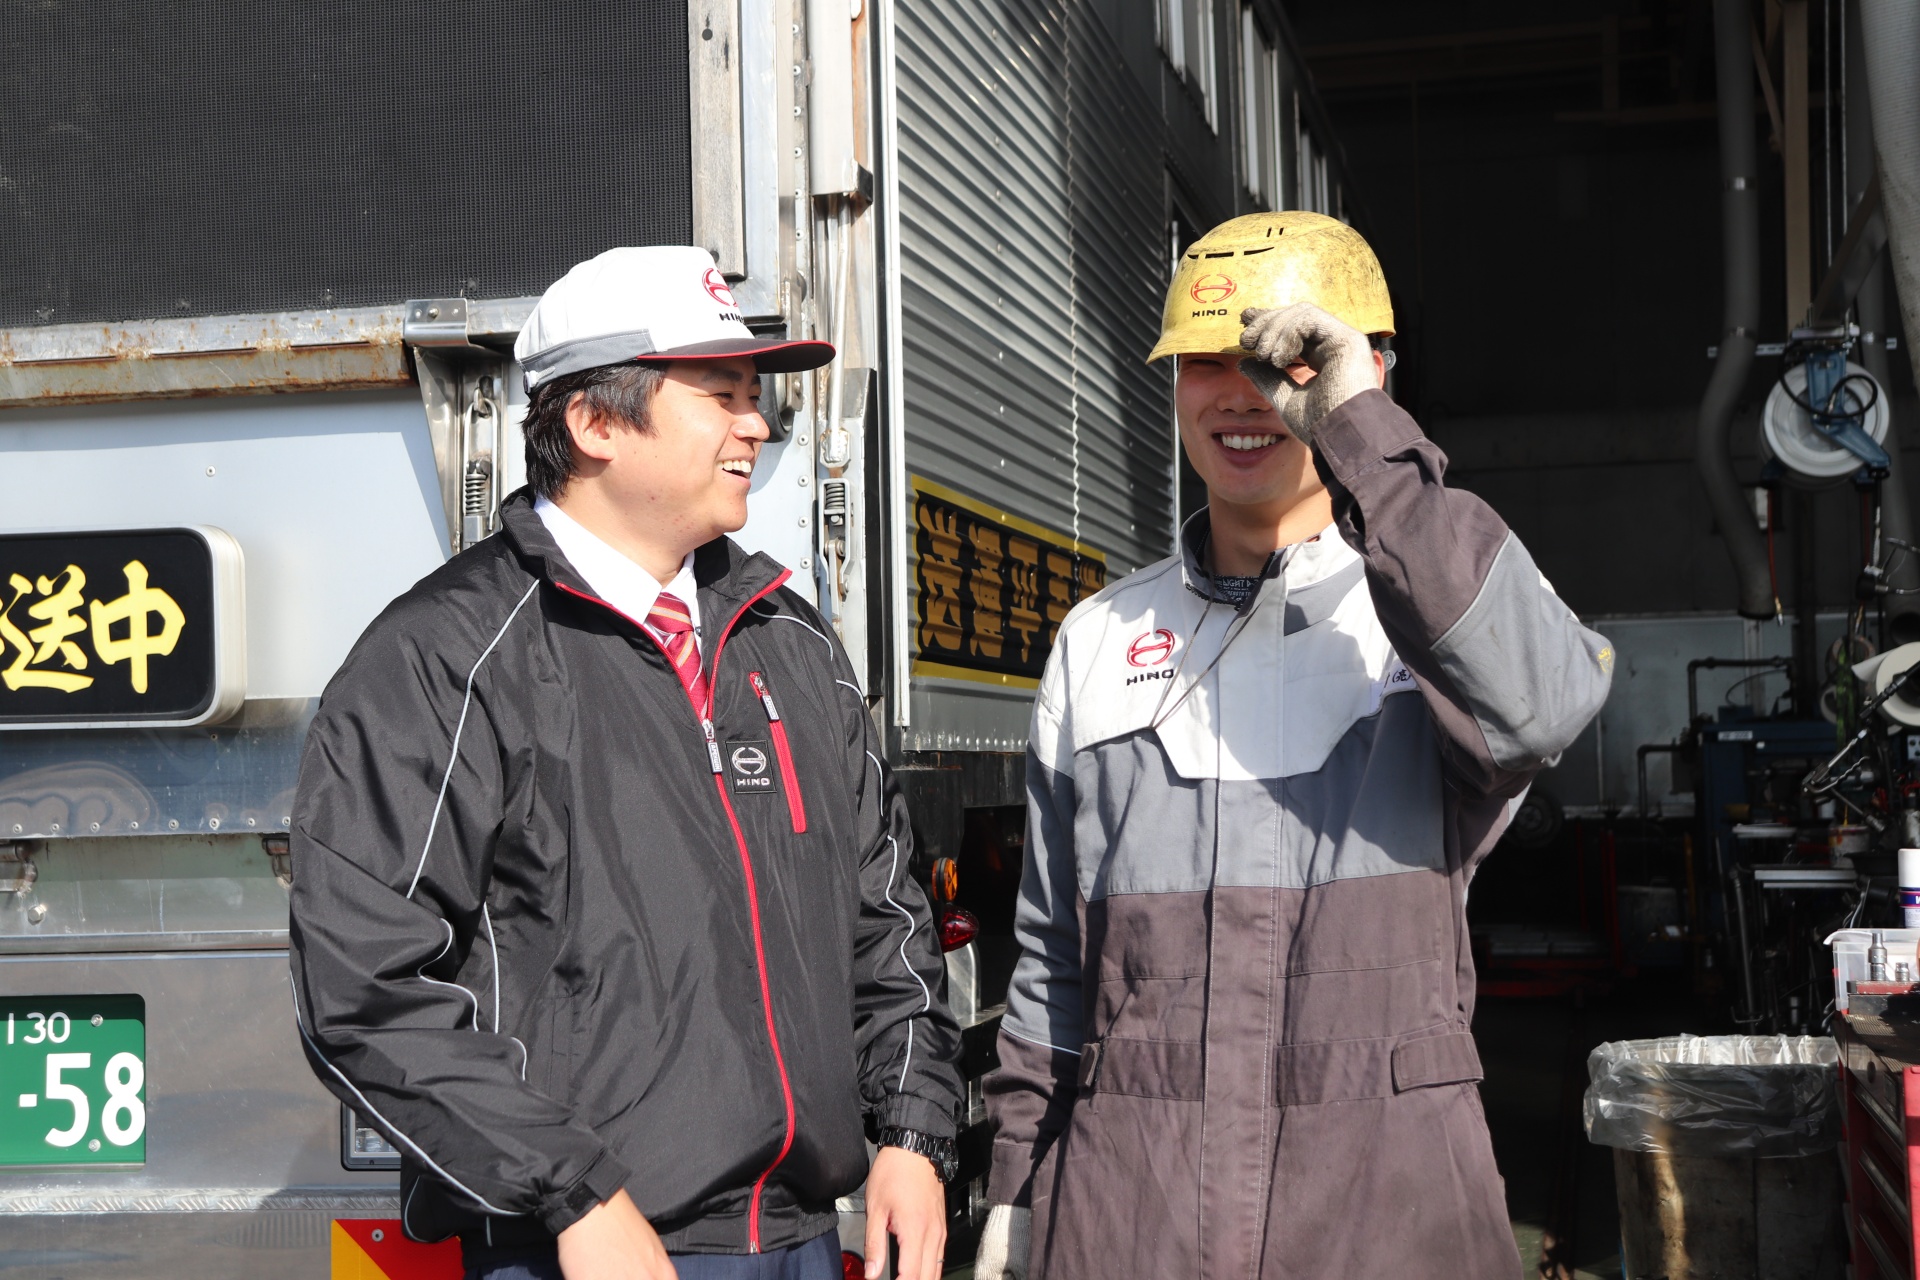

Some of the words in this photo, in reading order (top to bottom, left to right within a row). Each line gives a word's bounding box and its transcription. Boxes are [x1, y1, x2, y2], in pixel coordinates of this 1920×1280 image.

[1192, 309, 1228, 318] HINO
[0, 559, 187, 694] 送中
[1126, 669, 1174, 686] HINO
[736, 777, 770, 786] HINO
[7, 1011, 71, 1045] 130
